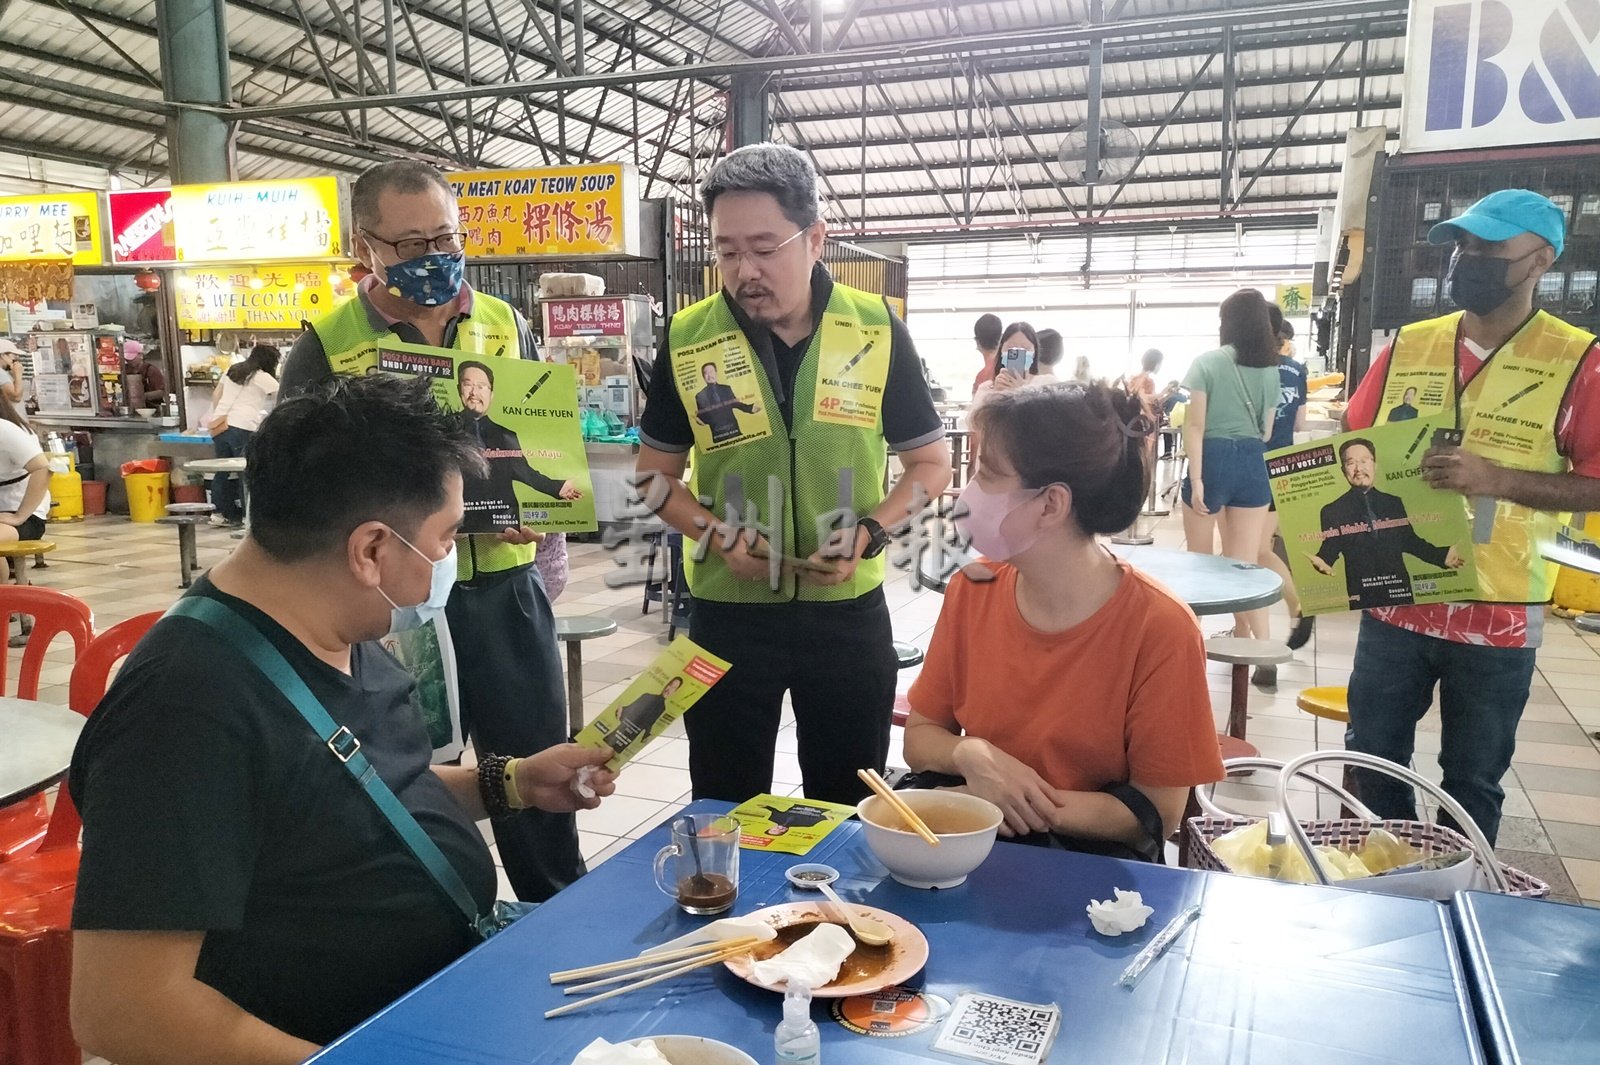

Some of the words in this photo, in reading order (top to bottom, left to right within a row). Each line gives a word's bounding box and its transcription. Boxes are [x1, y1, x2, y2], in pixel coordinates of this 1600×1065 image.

[467, 180, 501, 197] MEAT
[503, 178, 537, 196] KOAY
[540, 176, 578, 194] TEOW
[579, 174, 615, 192] SOUP
[207, 191, 242, 206] KUIH
[257, 188, 299, 203] MUIH
[0, 206, 30, 218] RRY
[40, 204, 68, 217] MEE
[458, 203, 517, 224] 西刀魚丸
[522, 198, 614, 245] 粿條湯
[213, 292, 301, 308] WELCOME
[246, 310, 285, 323] THANK
[834, 320, 852, 328] UNDI
[695, 340, 718, 353] BAYAN
[382, 360, 403, 370] UNDI
[412, 364, 433, 373] VOTE
[1525, 367, 1543, 375] VOTE
[821, 378, 839, 387] KAN
[841, 381, 863, 390] CHEE
[864, 384, 882, 394] YUEN
[820, 396, 841, 410] 4P
[502, 406, 522, 415] KAN
[524, 407, 547, 417] CHEE
[549, 409, 574, 418] YUEN
[1476, 411, 1494, 420] KAN
[1495, 415, 1518, 424] CHEE
[1520, 419, 1543, 430] YUEN
[1470, 428, 1491, 439] 4P
[538, 449, 562, 459] Maju
[1286, 453, 1312, 464] BAYAN
[1270, 465, 1290, 476] UNDI
[1297, 458, 1317, 469] VOTE
[1385, 471, 1403, 481] KAN
[1276, 479, 1289, 491] 4P
